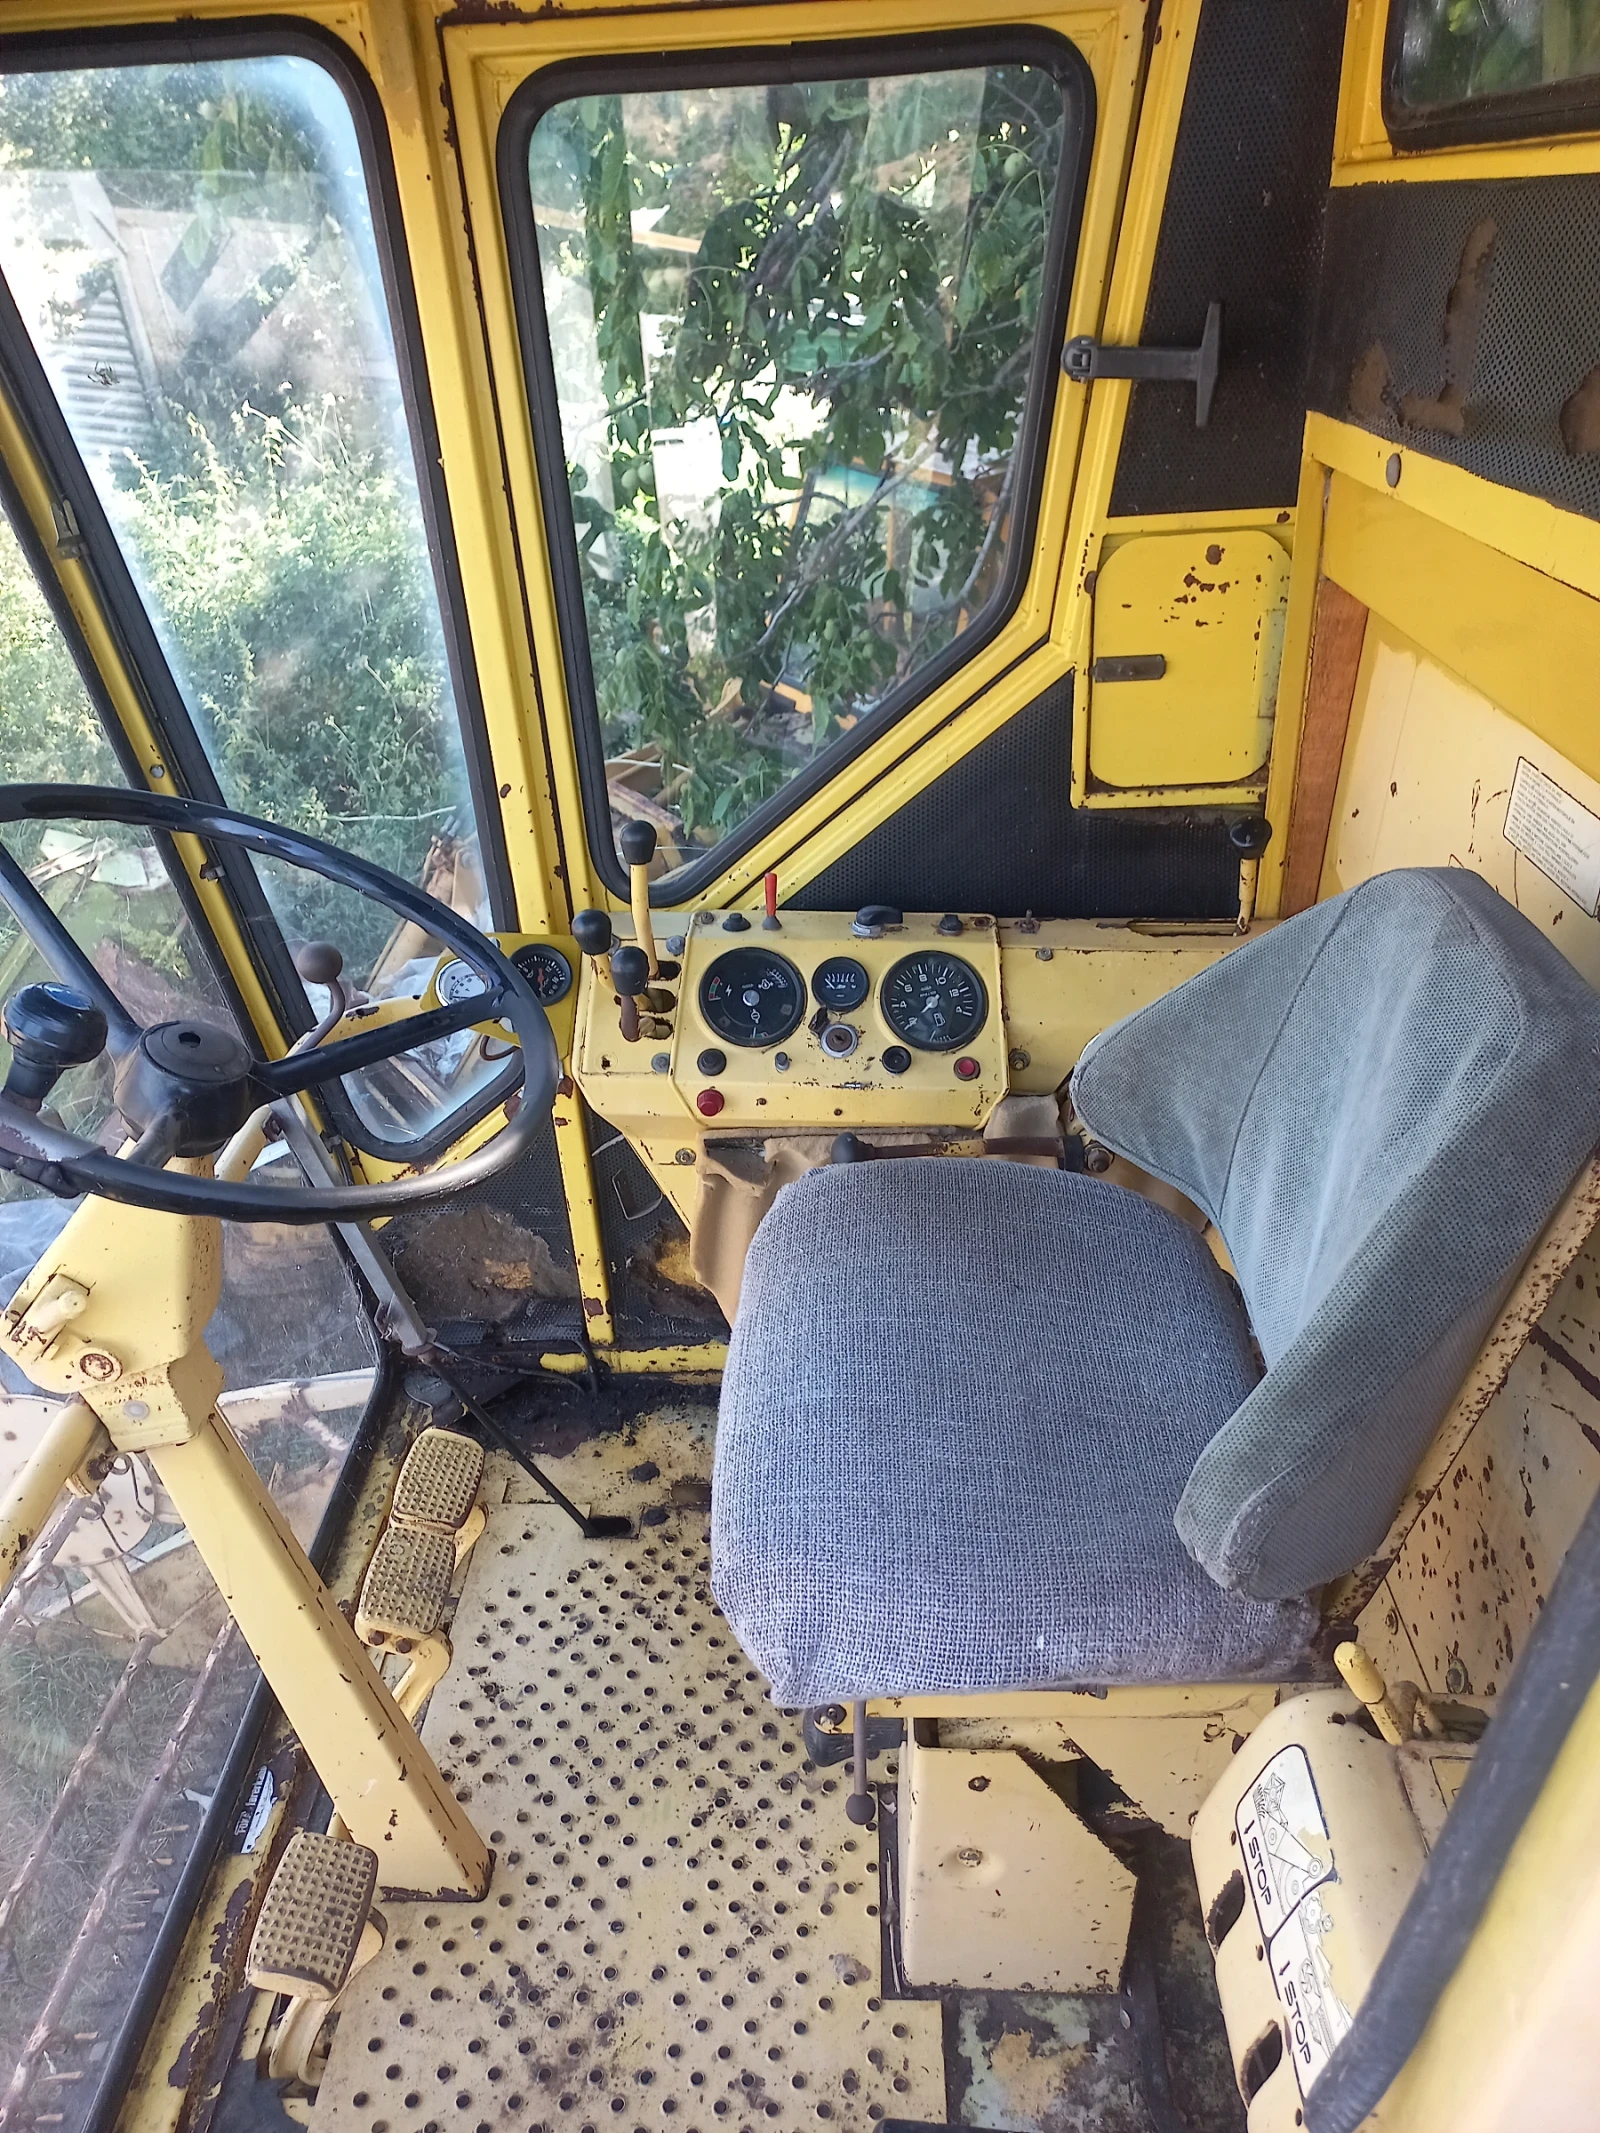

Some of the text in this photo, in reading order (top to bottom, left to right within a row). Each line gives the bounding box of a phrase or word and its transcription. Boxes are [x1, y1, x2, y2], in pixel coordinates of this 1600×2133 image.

[919, 974, 928, 982] 8
[935, 976, 947, 985] 10
[904, 984, 913, 993] 6
[949, 988, 960, 998] 12
[900, 1000, 907, 1009] 4
[1248, 1836, 1272, 1906] STOP
[1284, 1980, 1311, 2064] STOP
